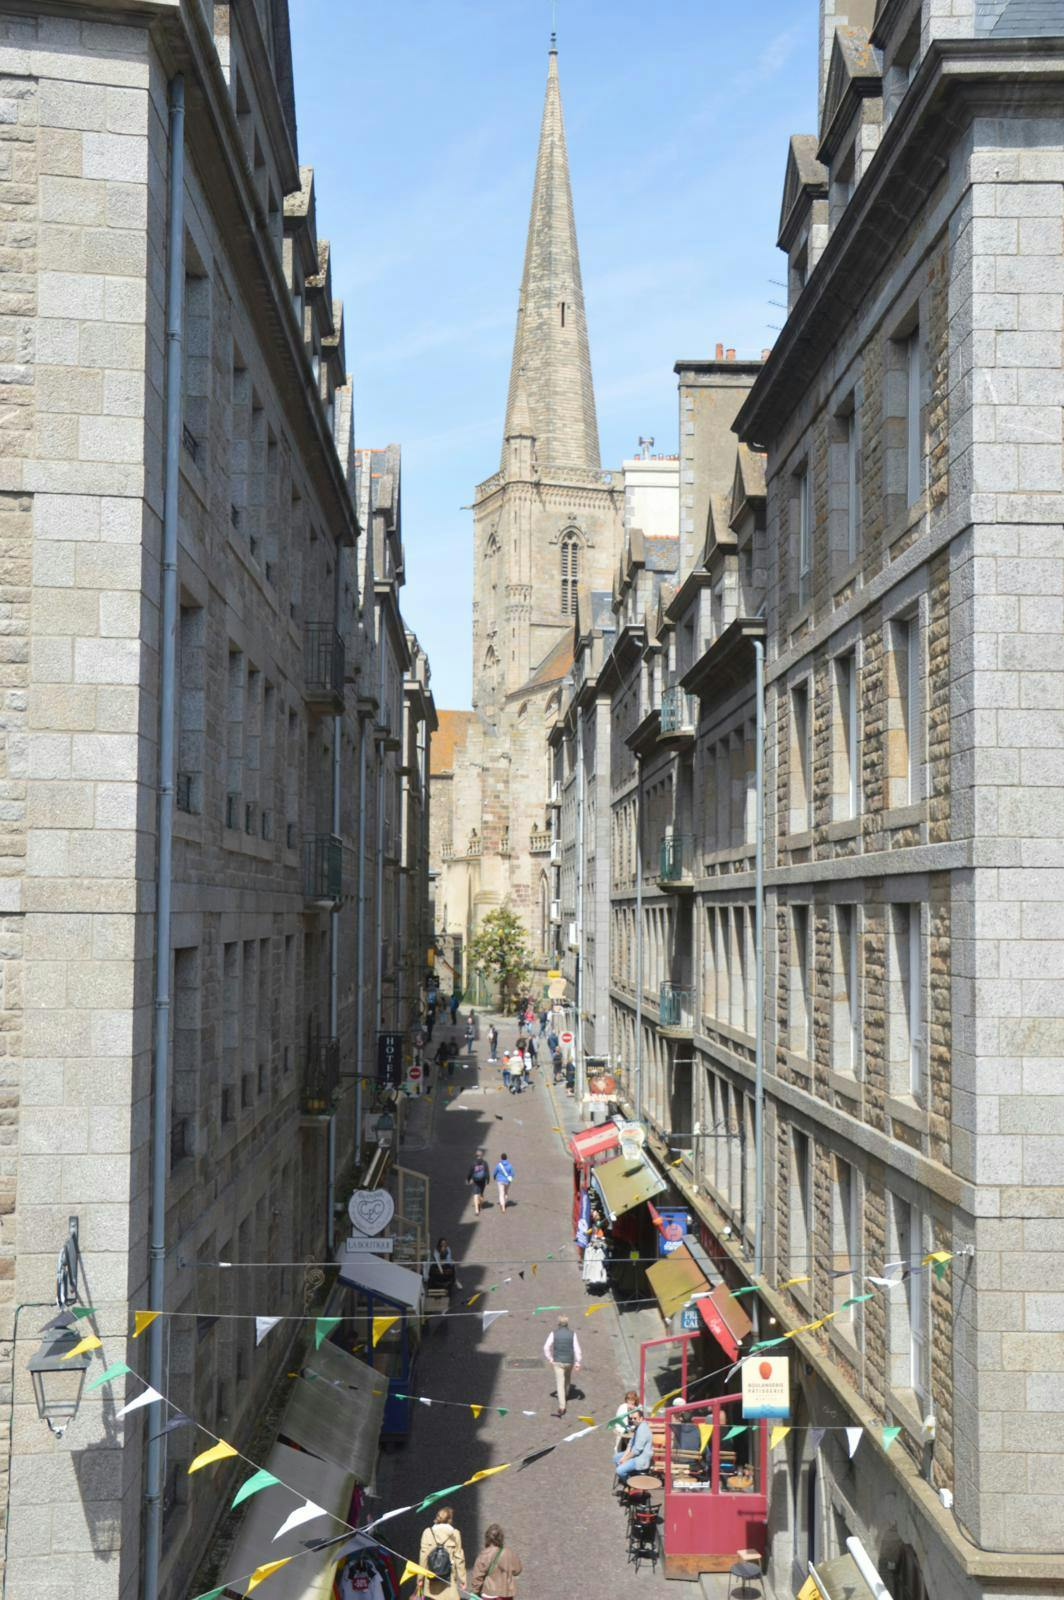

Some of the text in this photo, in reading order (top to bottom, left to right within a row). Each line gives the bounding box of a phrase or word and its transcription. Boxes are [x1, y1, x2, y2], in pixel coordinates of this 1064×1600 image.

[386, 1037, 395, 1081] HOTEL
[348, 1240, 390, 1250] LA BOUTIQUE
